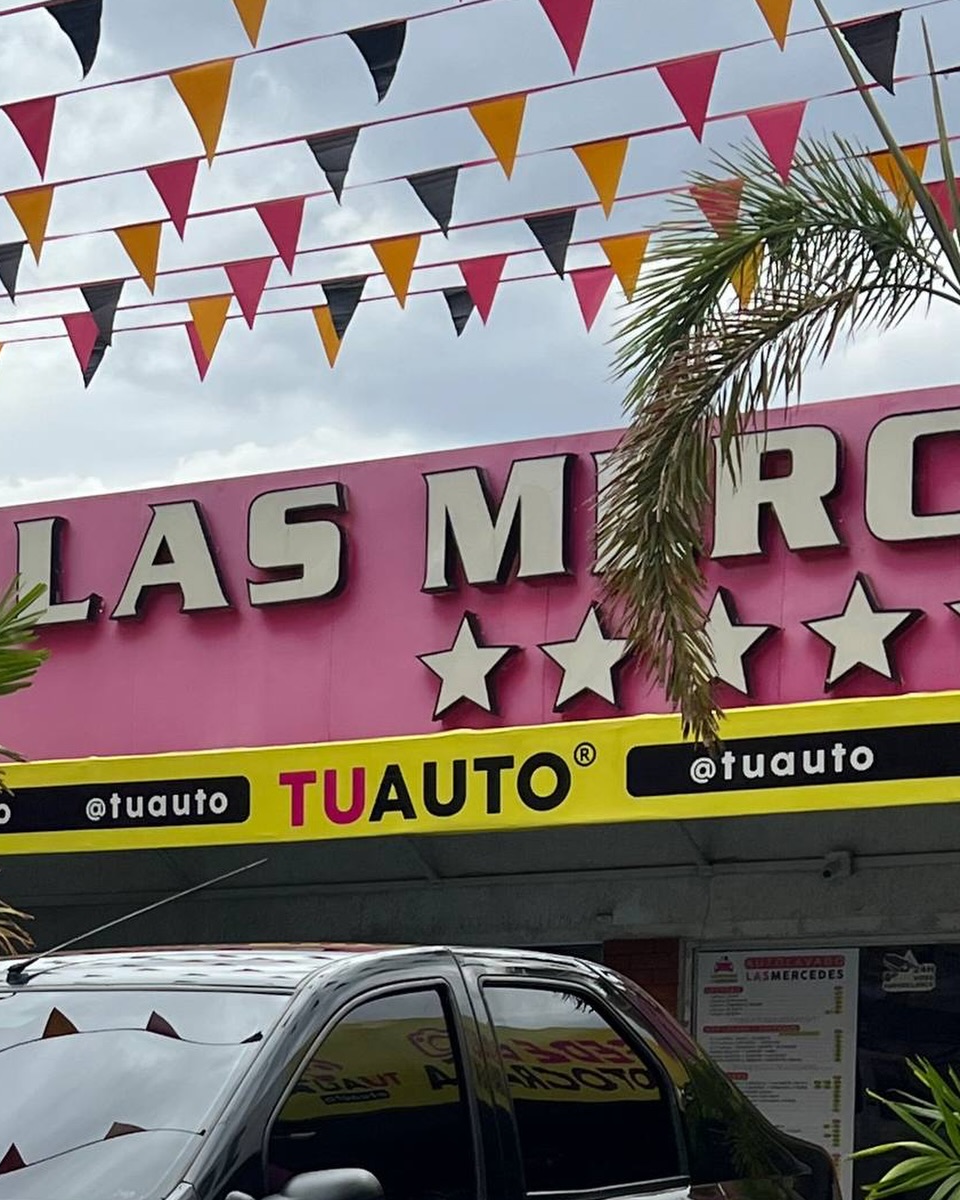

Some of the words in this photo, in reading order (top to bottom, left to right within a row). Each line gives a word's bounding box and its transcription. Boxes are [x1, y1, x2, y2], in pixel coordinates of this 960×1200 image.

[14, 481, 347, 628] LAS
[690, 740, 876, 784] @tuauto
[85, 788, 230, 822] @tuauto
